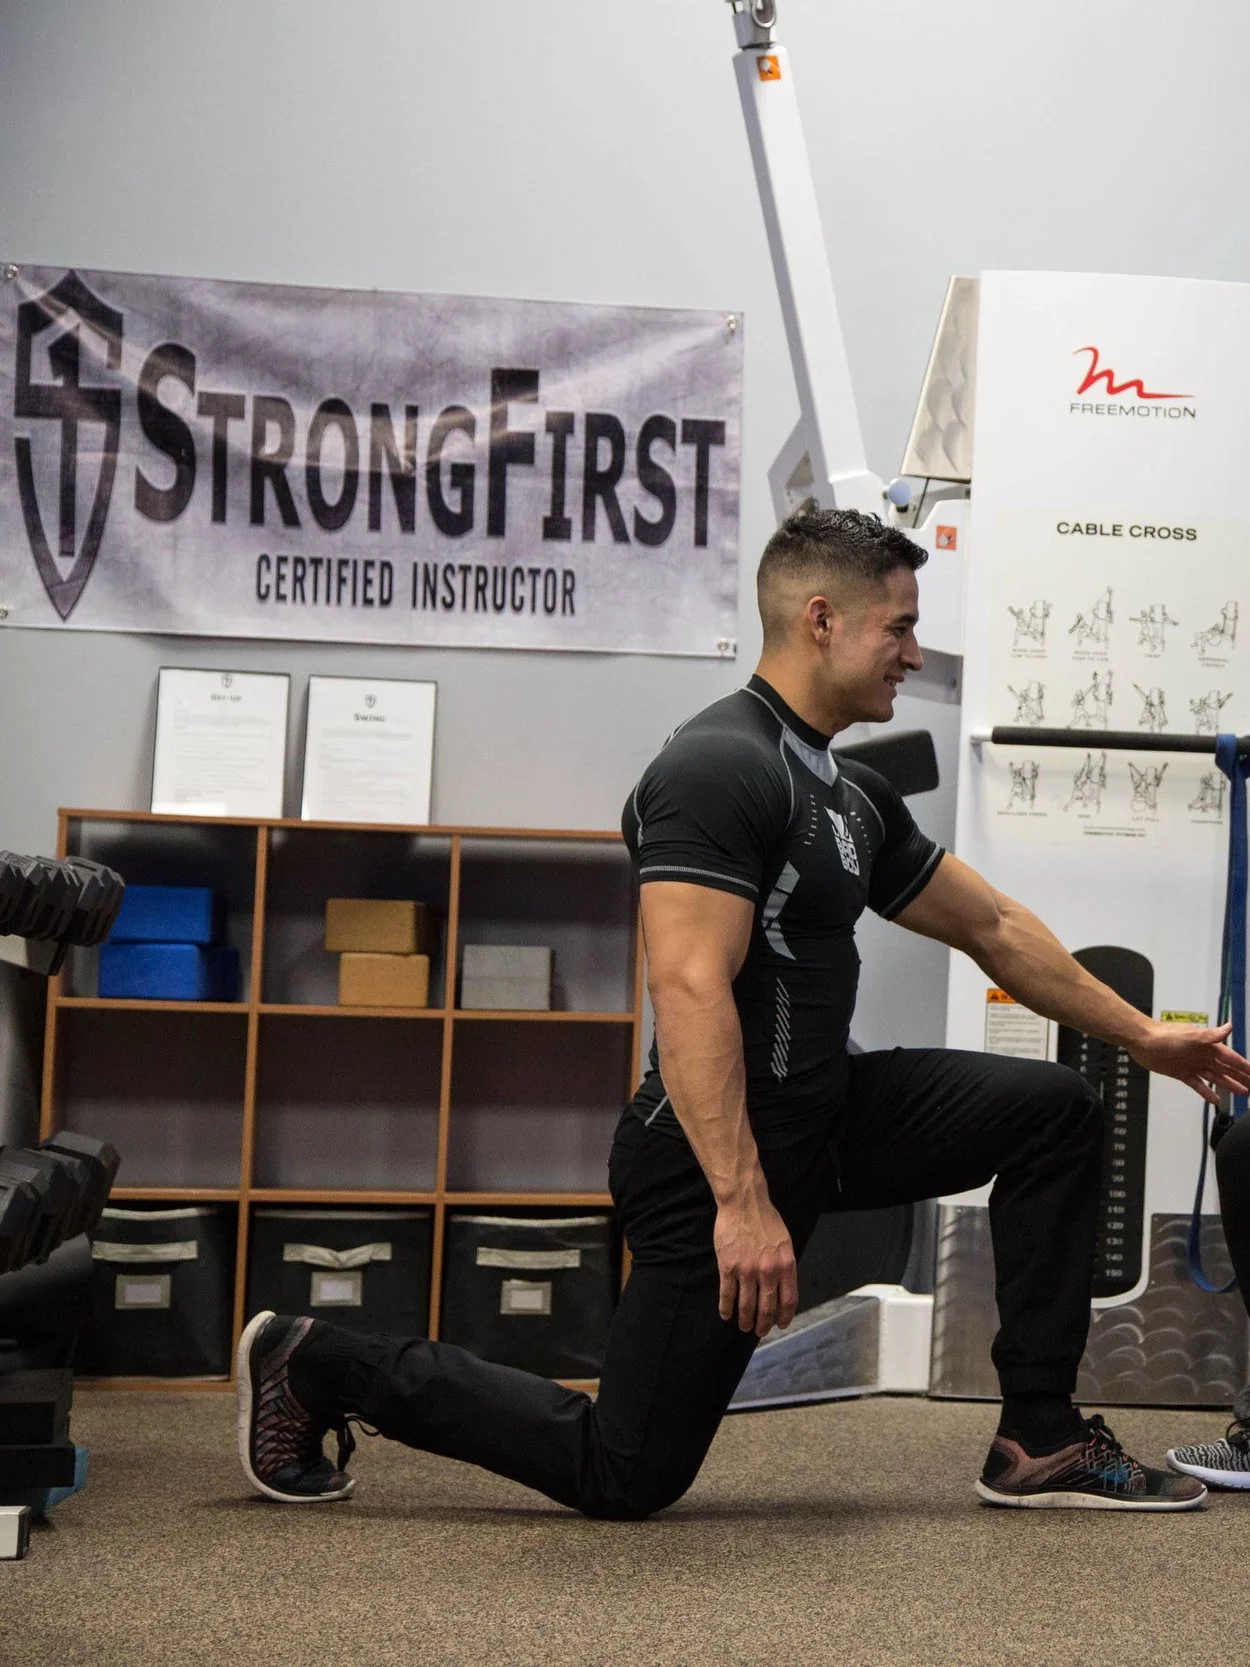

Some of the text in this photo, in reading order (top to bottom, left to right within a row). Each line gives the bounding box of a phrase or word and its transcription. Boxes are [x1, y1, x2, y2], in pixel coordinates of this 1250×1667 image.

[1069, 402, 1197, 419] FREEMOTION
[1056, 521, 1198, 541] CABLE CROSS
[255, 553, 577, 616] CERTIFIED INSTRUCTOR
[1108, 1190, 1126, 1198] 100
[1108, 1206, 1125, 1214] 110
[1107, 1222, 1124, 1230] 120
[1105, 1268, 1124, 1277] 150
